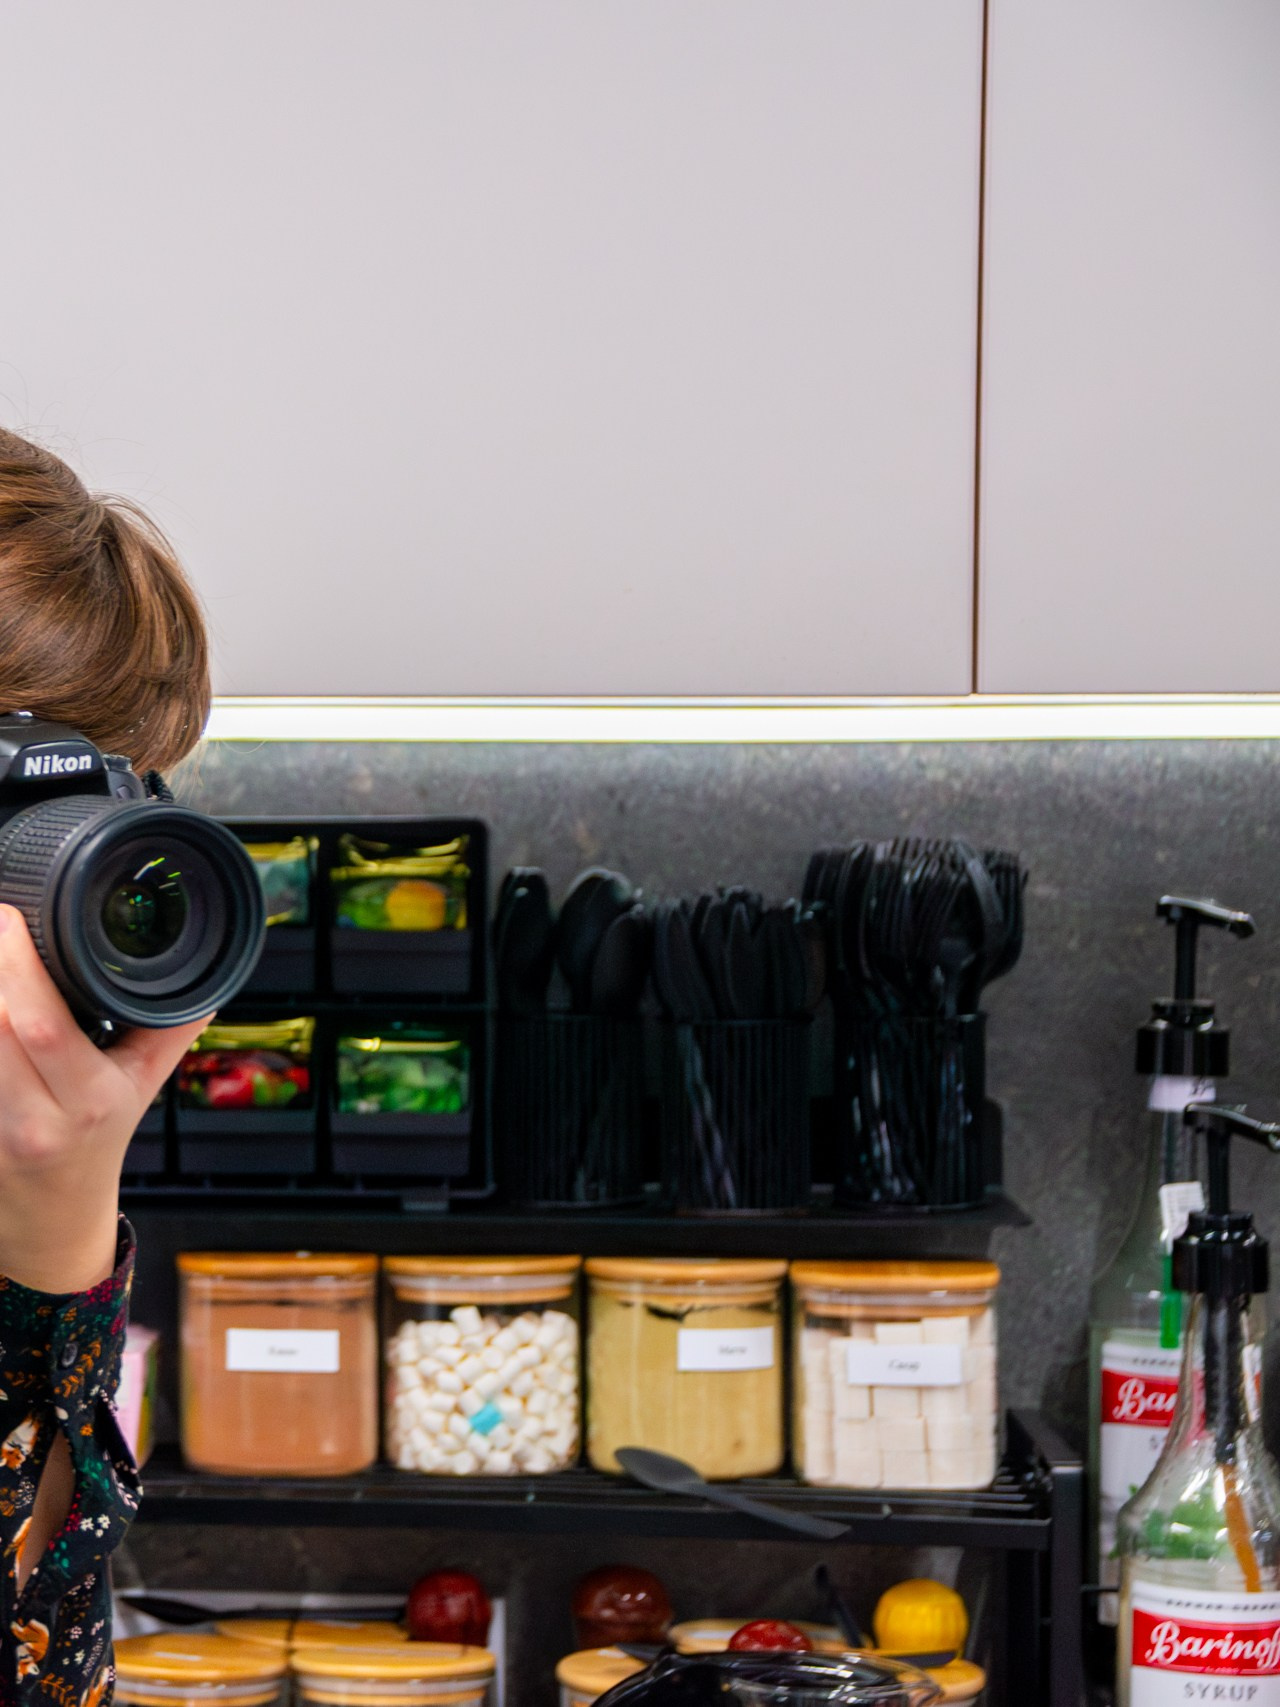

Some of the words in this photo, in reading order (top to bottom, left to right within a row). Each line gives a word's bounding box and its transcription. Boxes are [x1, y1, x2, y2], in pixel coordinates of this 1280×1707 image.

[24, 754, 93, 776] Nikon
[1112, 1377, 1178, 1420] Bar
[1183, 1681, 1260, 1701] SYRUP
